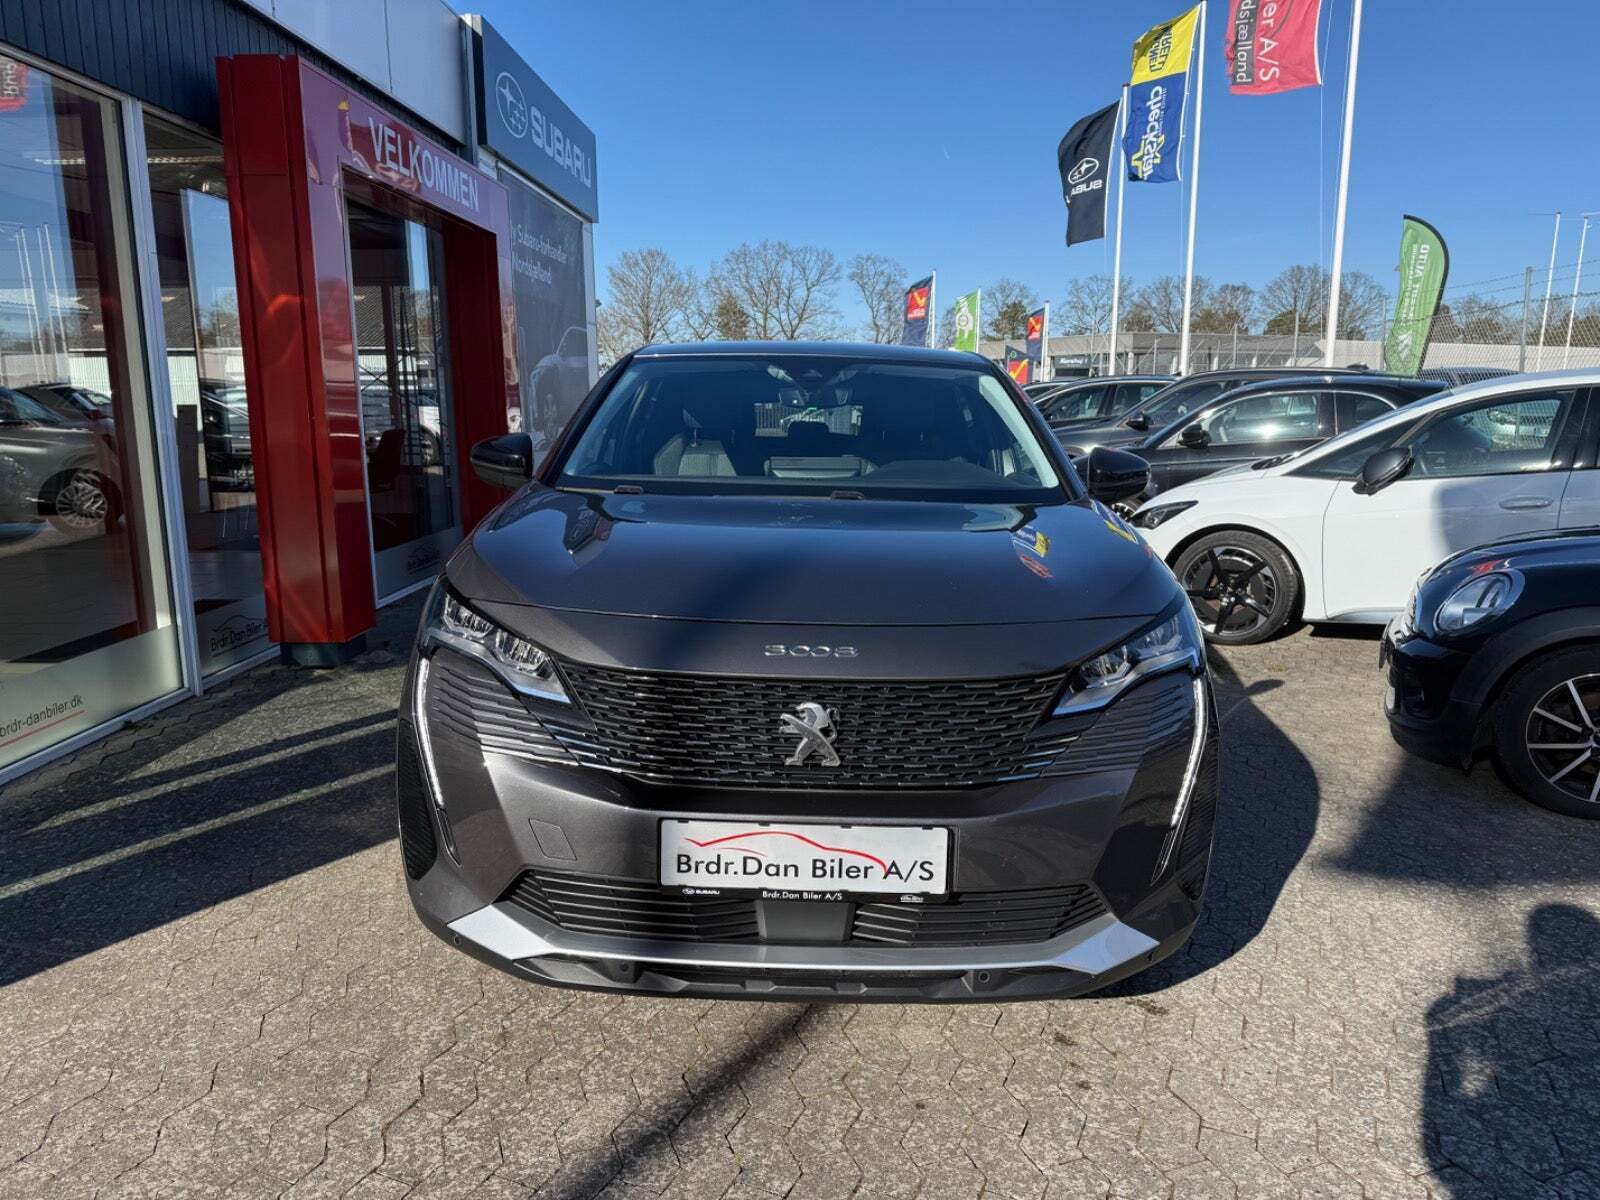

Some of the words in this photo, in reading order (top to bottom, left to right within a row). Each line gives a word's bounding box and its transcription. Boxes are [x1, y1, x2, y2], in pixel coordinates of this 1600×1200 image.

[1257, 37, 1280, 81] A/S
[368, 116, 480, 212] VELKOMMEN
[530, 106, 592, 188] SUBARU
[764, 644, 859, 658] 3008
[676, 854, 799, 878] Brdr.Dan
[811, 858, 874, 880] Biler
[883, 859, 934, 882] A/S
[762, 890, 800, 899] Brdr.Dan
[803, 891, 822, 900] Biler
[825, 892, 843, 901] A/S
